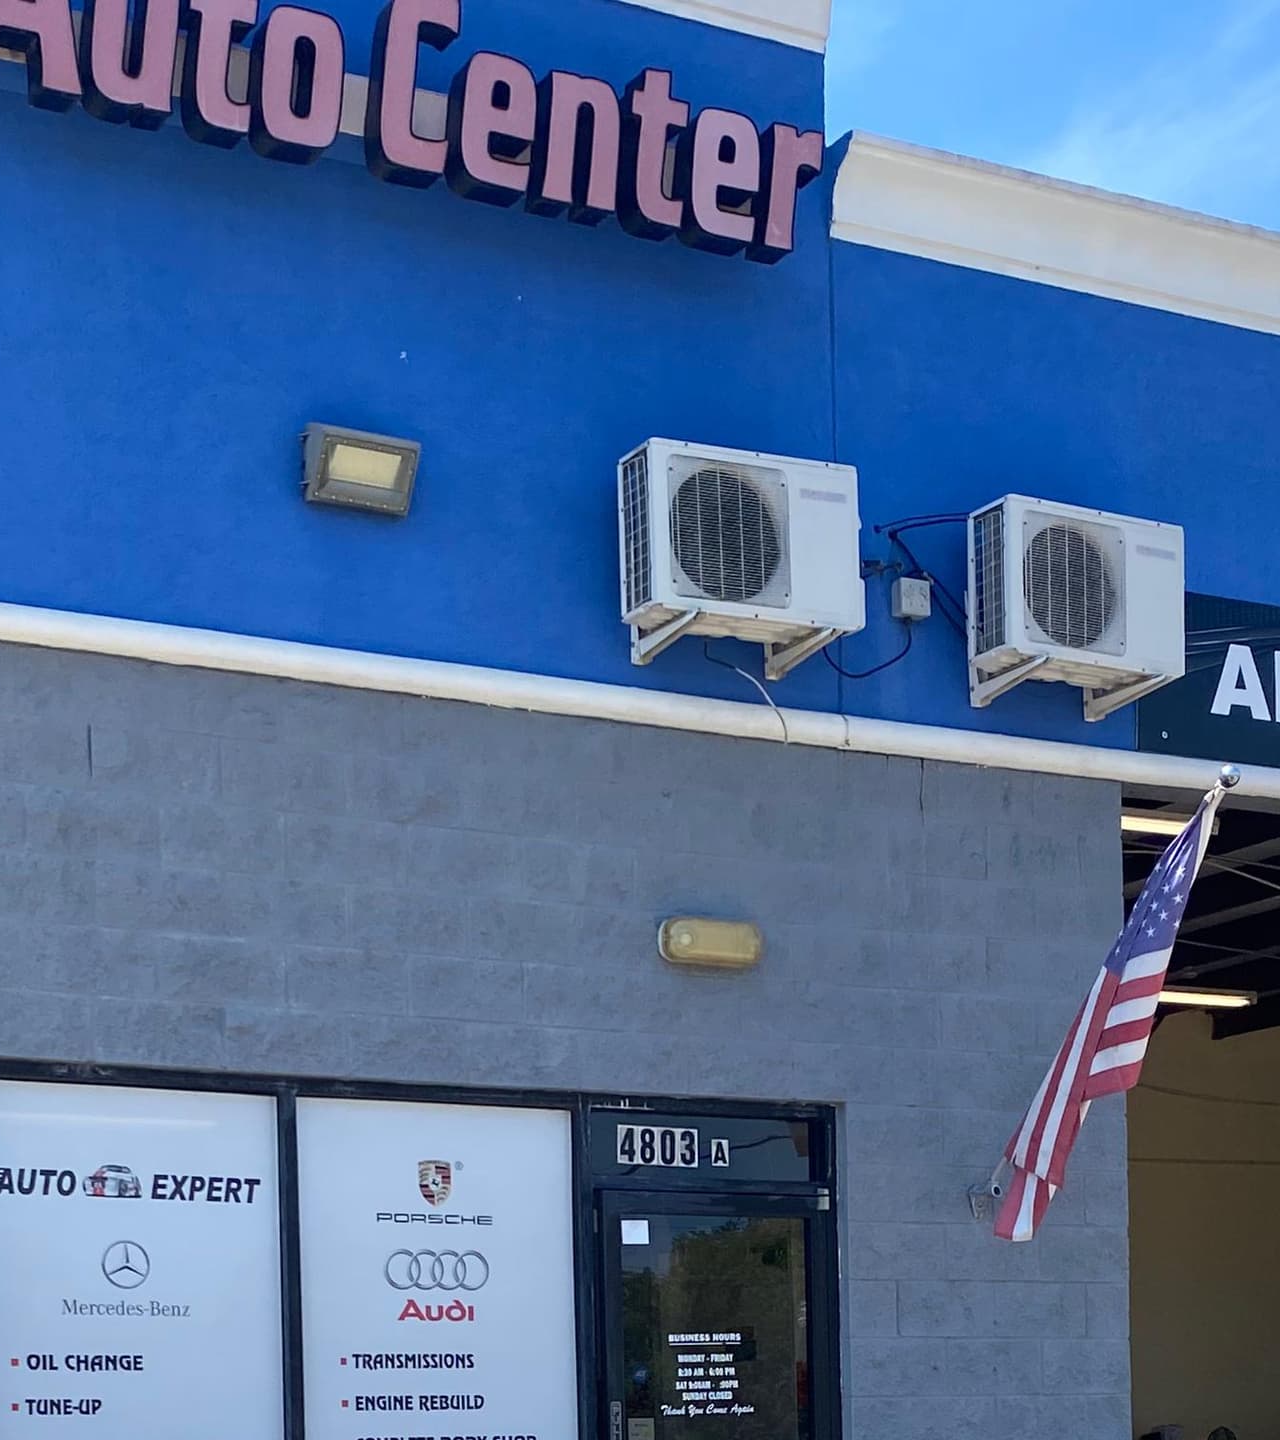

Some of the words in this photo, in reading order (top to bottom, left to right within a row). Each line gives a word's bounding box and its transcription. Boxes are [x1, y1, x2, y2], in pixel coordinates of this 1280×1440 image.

[365, 0, 824, 264] Center
[620, 1128, 696, 1165] 4803
[713, 1141, 728, 1164] A
[151, 1174, 261, 1203] EXPERT
[376, 1213, 493, 1225] PORSCHE
[61, 1299, 191, 1318] Mercedes-Benz
[397, 1299, 474, 1321] Audi
[668, 1334, 710, 1342] BUSINESS
[26, 1354, 58, 1371] OIL
[64, 1354, 144, 1372] CHANGE
[352, 1354, 474, 1370] TRANSMISSIONS
[25, 1399, 102, 1415] TUNE-UP
[355, 1396, 413, 1411] ENGINE
[419, 1395, 485, 1411] REBUILD
[660, 1405, 686, 1416] Thank
[687, 1404, 704, 1418] You
